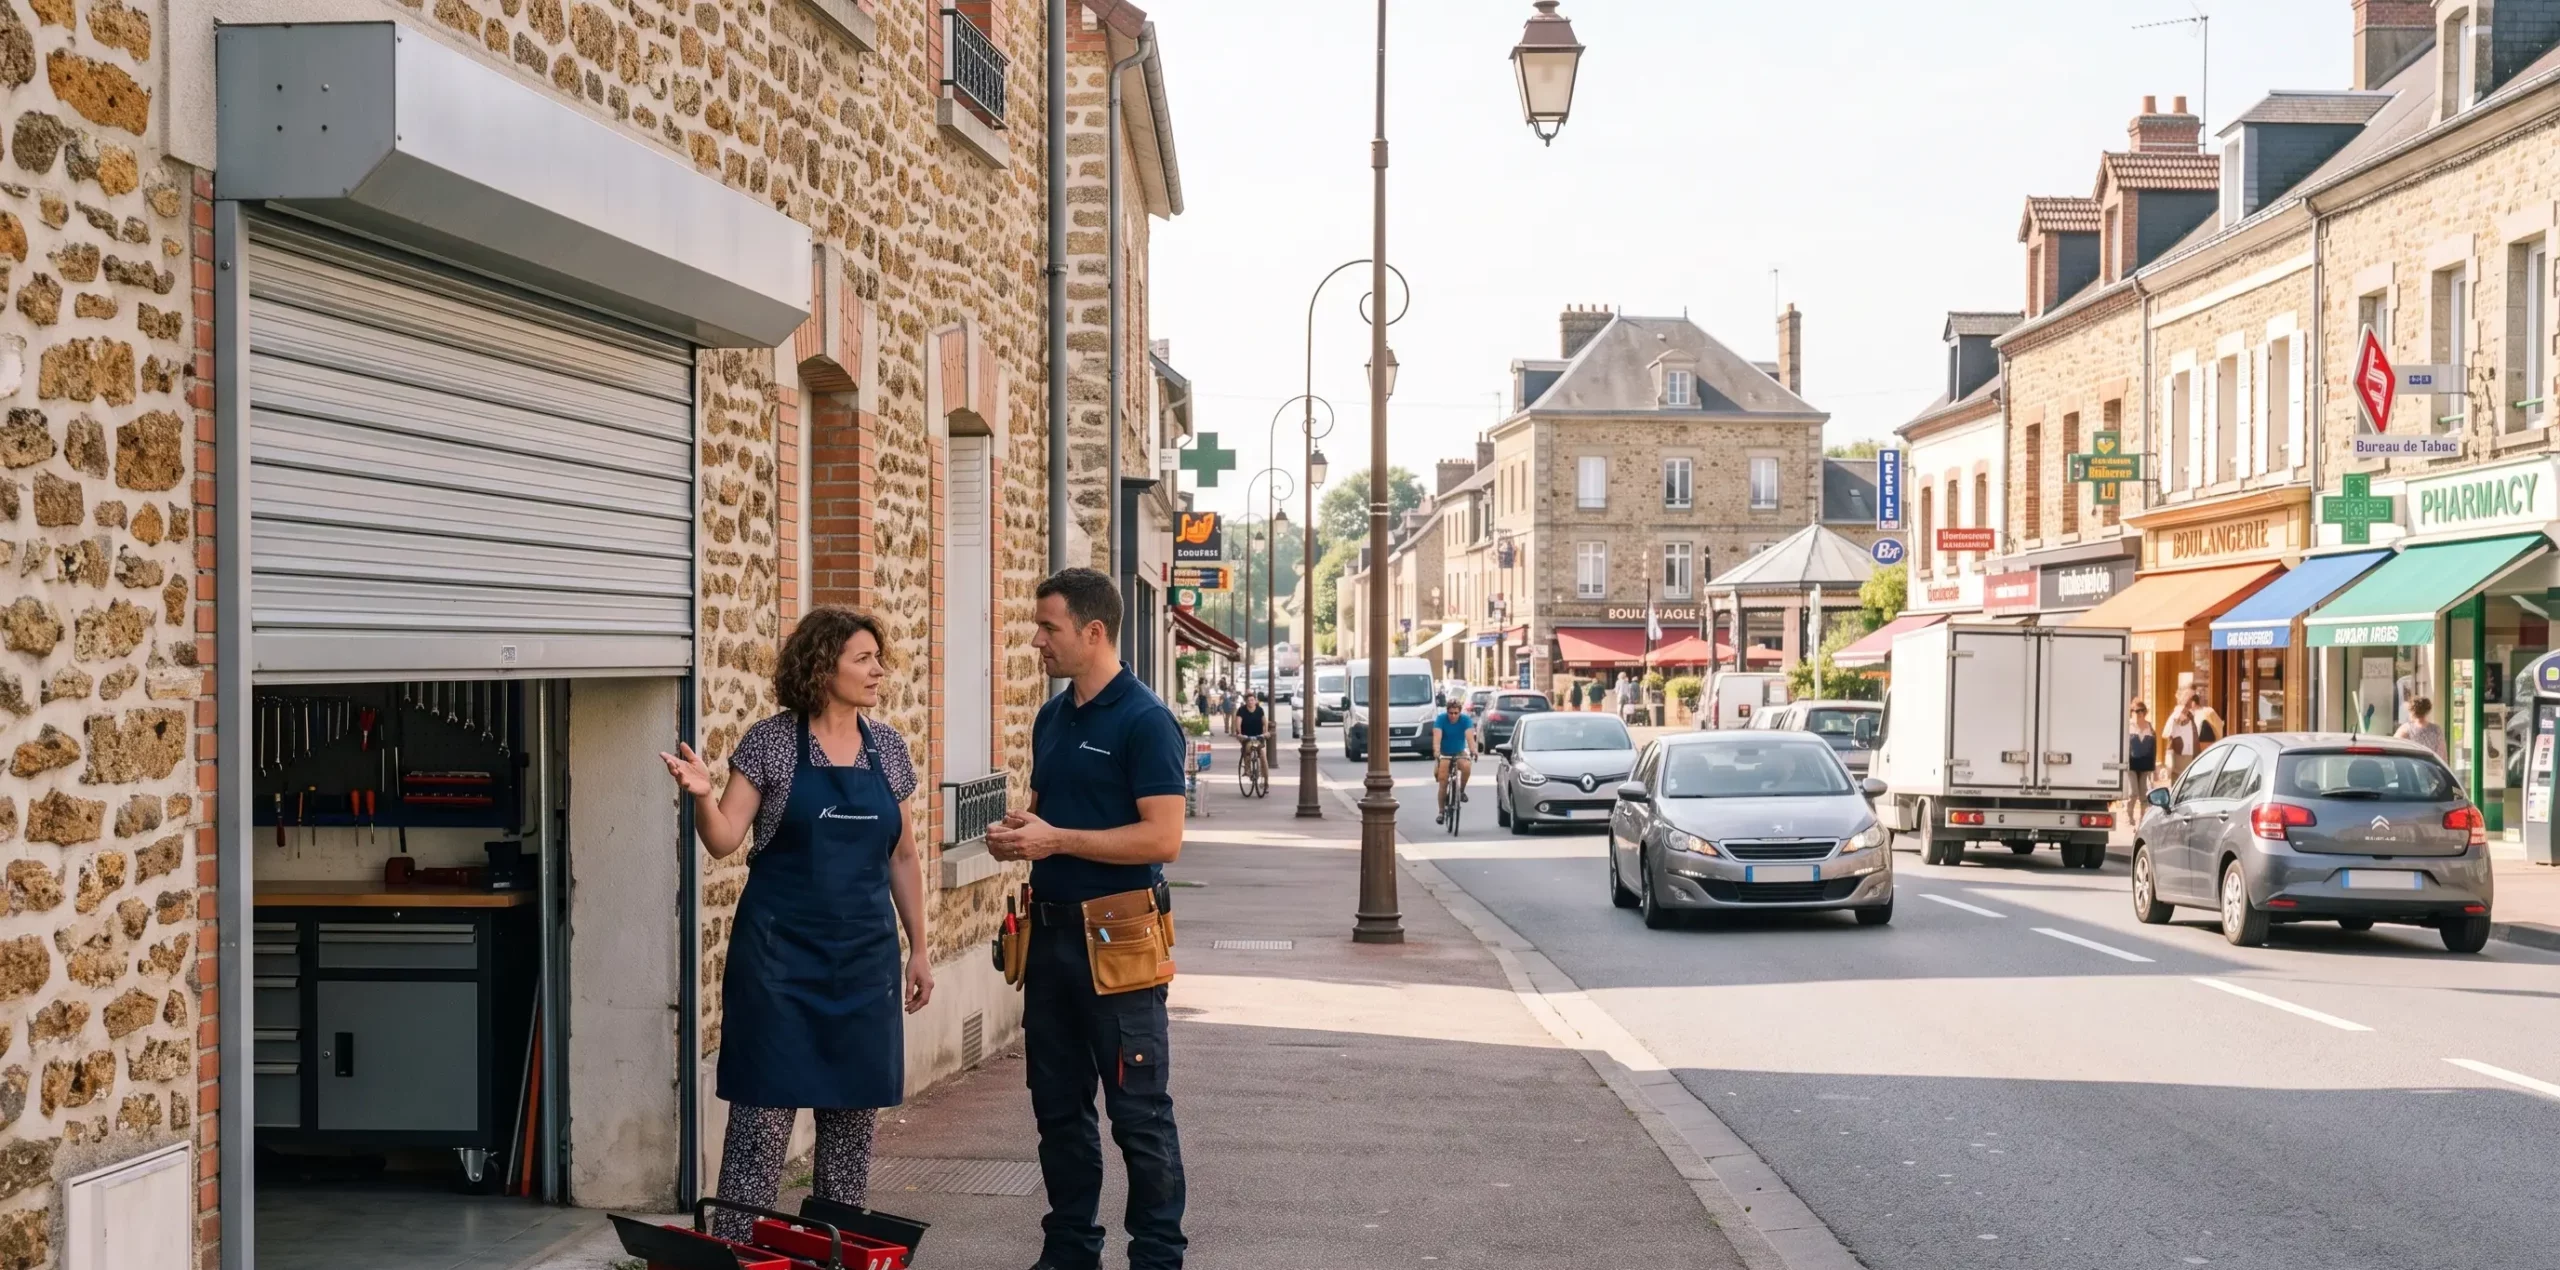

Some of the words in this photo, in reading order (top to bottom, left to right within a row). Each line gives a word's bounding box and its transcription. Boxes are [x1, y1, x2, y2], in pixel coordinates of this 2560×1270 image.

[2356, 440, 2400, 452] Bureau
[2403, 440, 2418, 452] de
[2420, 440, 2457, 452] Tabac
[2420, 472, 2538, 525] PHARMACY
[2172, 518, 2270, 560] BOULANGERIE
